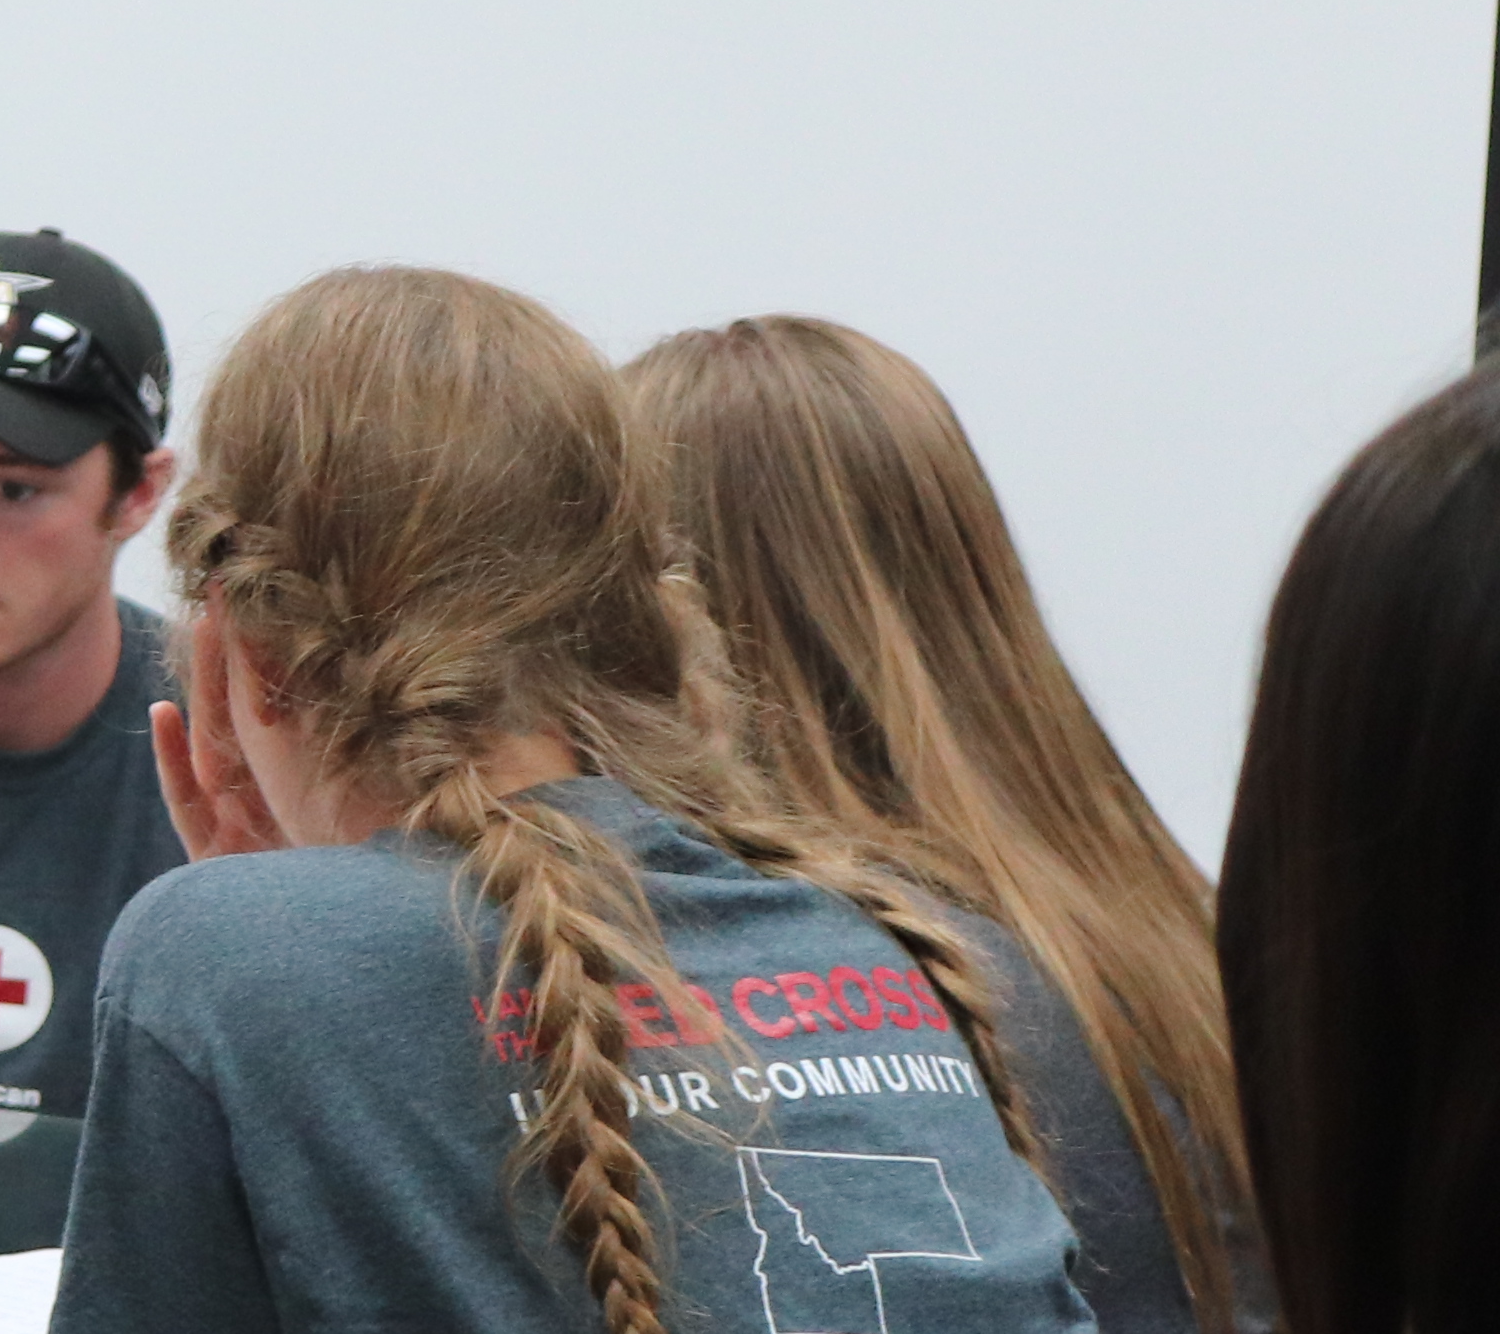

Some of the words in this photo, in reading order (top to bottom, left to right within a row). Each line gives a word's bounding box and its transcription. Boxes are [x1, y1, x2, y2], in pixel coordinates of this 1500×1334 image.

[615, 982, 726, 1047] ED
[732, 966, 949, 1039] CROSS
[493, 1029, 536, 1062] TH
[731, 1054, 980, 1103] COMMUNITY
